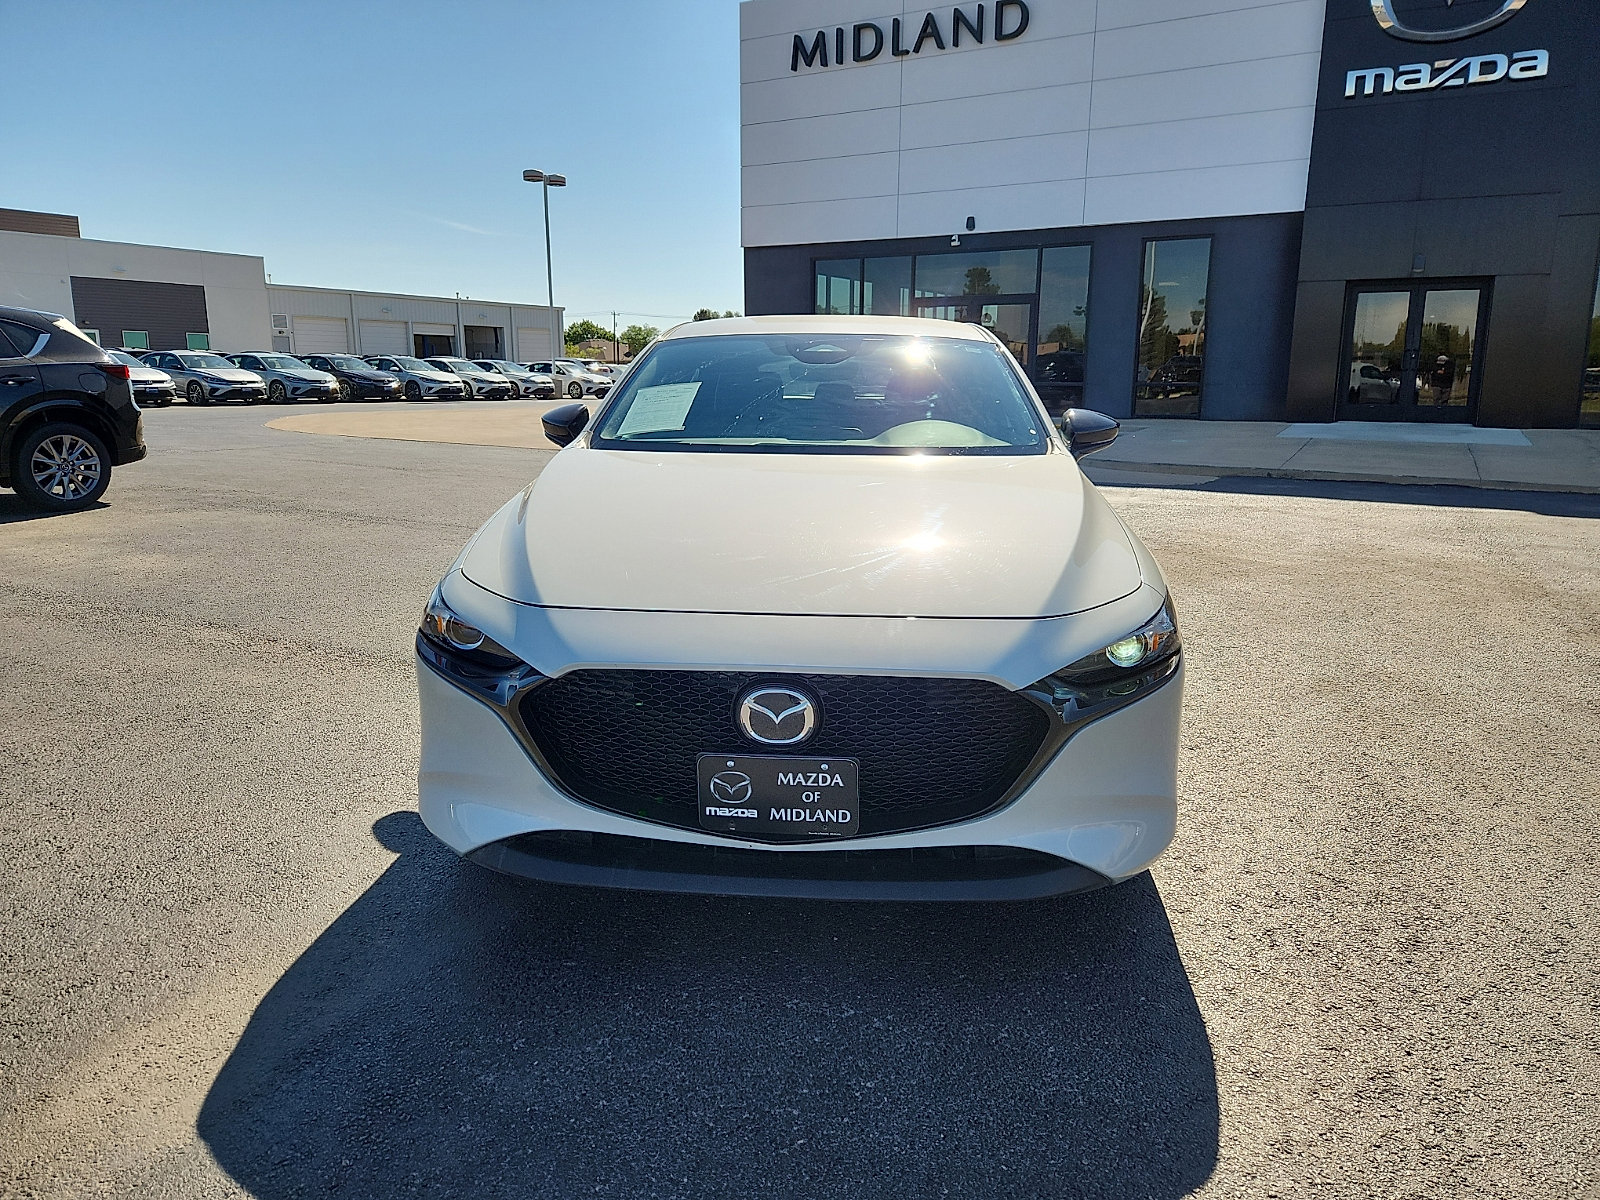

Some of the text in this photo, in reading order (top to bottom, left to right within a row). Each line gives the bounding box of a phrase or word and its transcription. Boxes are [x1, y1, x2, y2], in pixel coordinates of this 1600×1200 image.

[790, 0, 1030, 72] MIDLAND
[777, 772, 845, 787] MAZDA
[801, 791, 821, 803] OF
[769, 807, 851, 823] MIDLAND
